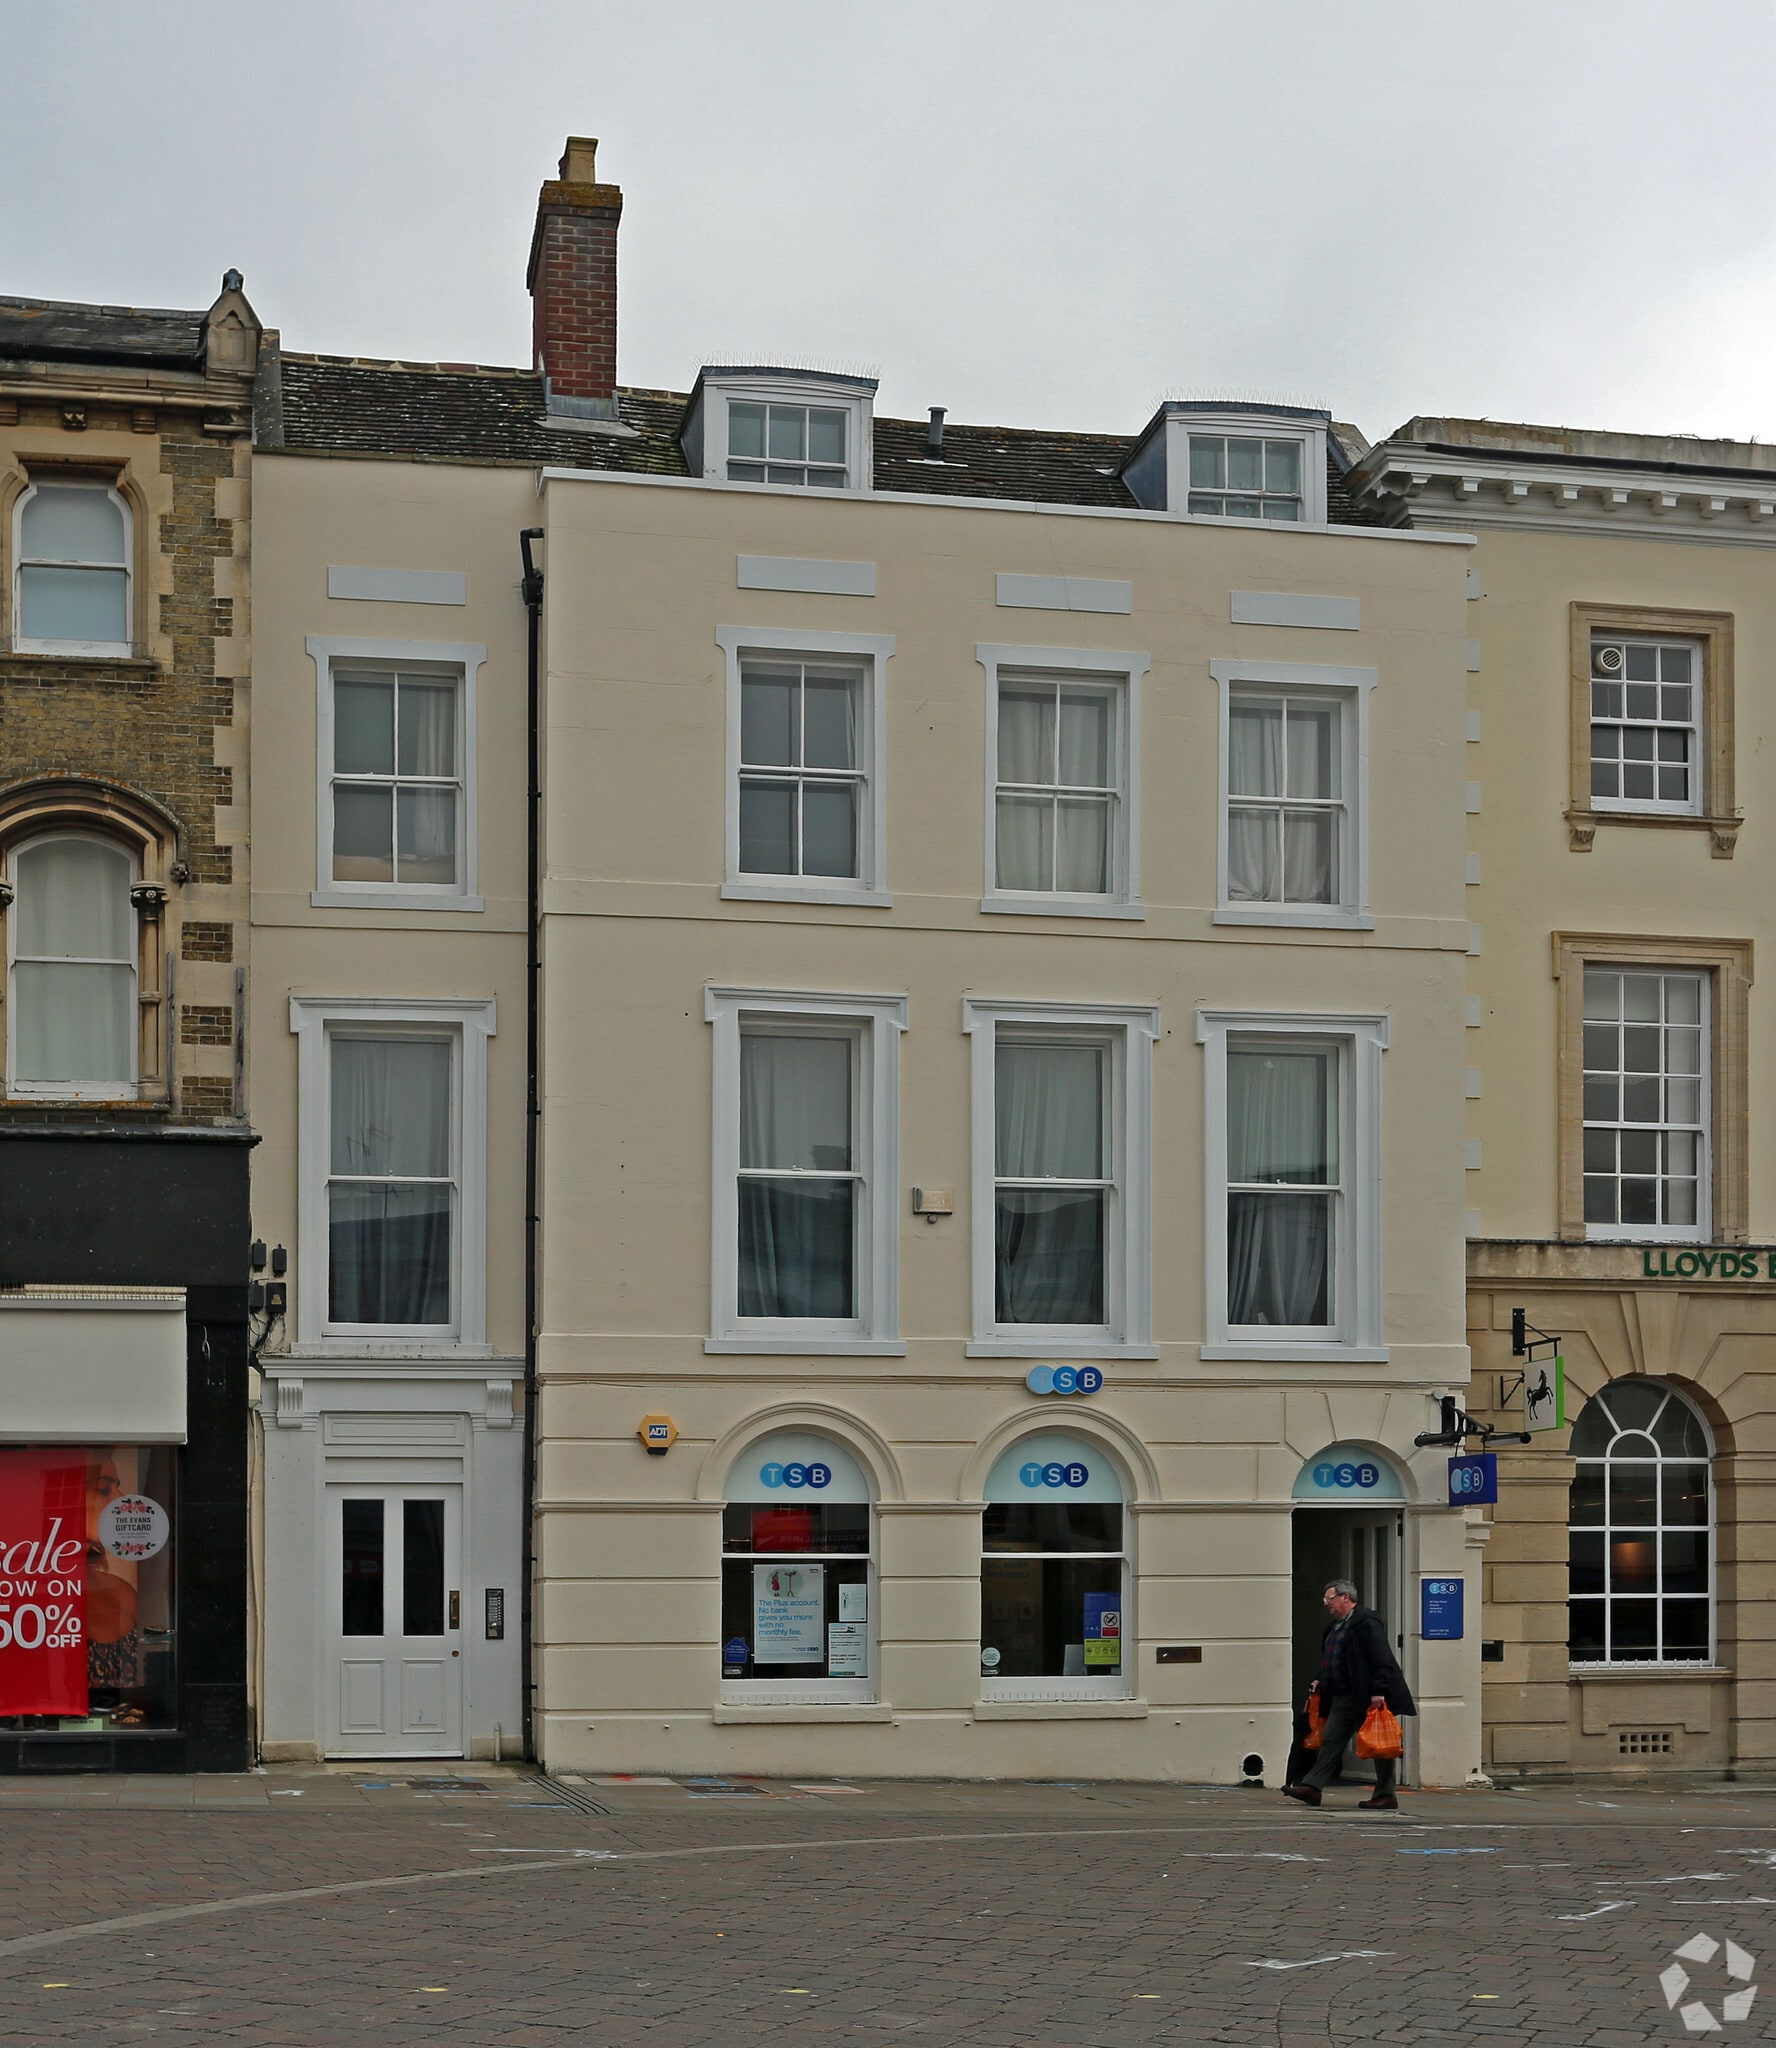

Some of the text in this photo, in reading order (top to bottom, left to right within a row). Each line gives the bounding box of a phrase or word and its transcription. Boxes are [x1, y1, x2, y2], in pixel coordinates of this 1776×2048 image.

[1644, 1251, 1759, 1278] LLOYDS
[1038, 1372, 1096, 1388] TSB
[649, 1426, 669, 1437] ADT
[767, 1467, 825, 1484] TSB
[1027, 1467, 1083, 1484] TSB
[1320, 1468, 1374, 1484] TSB
[116, 1524, 152, 1532] GIFTCARD
[47, 1580, 82, 1597] ON
[759, 1599, 772, 1607] The
[770, 1606, 789, 1614] bank
[758, 1613, 778, 1622] gives
[758, 1628, 788, 1637] monthly
[45, 1634, 82, 1649] OFF
